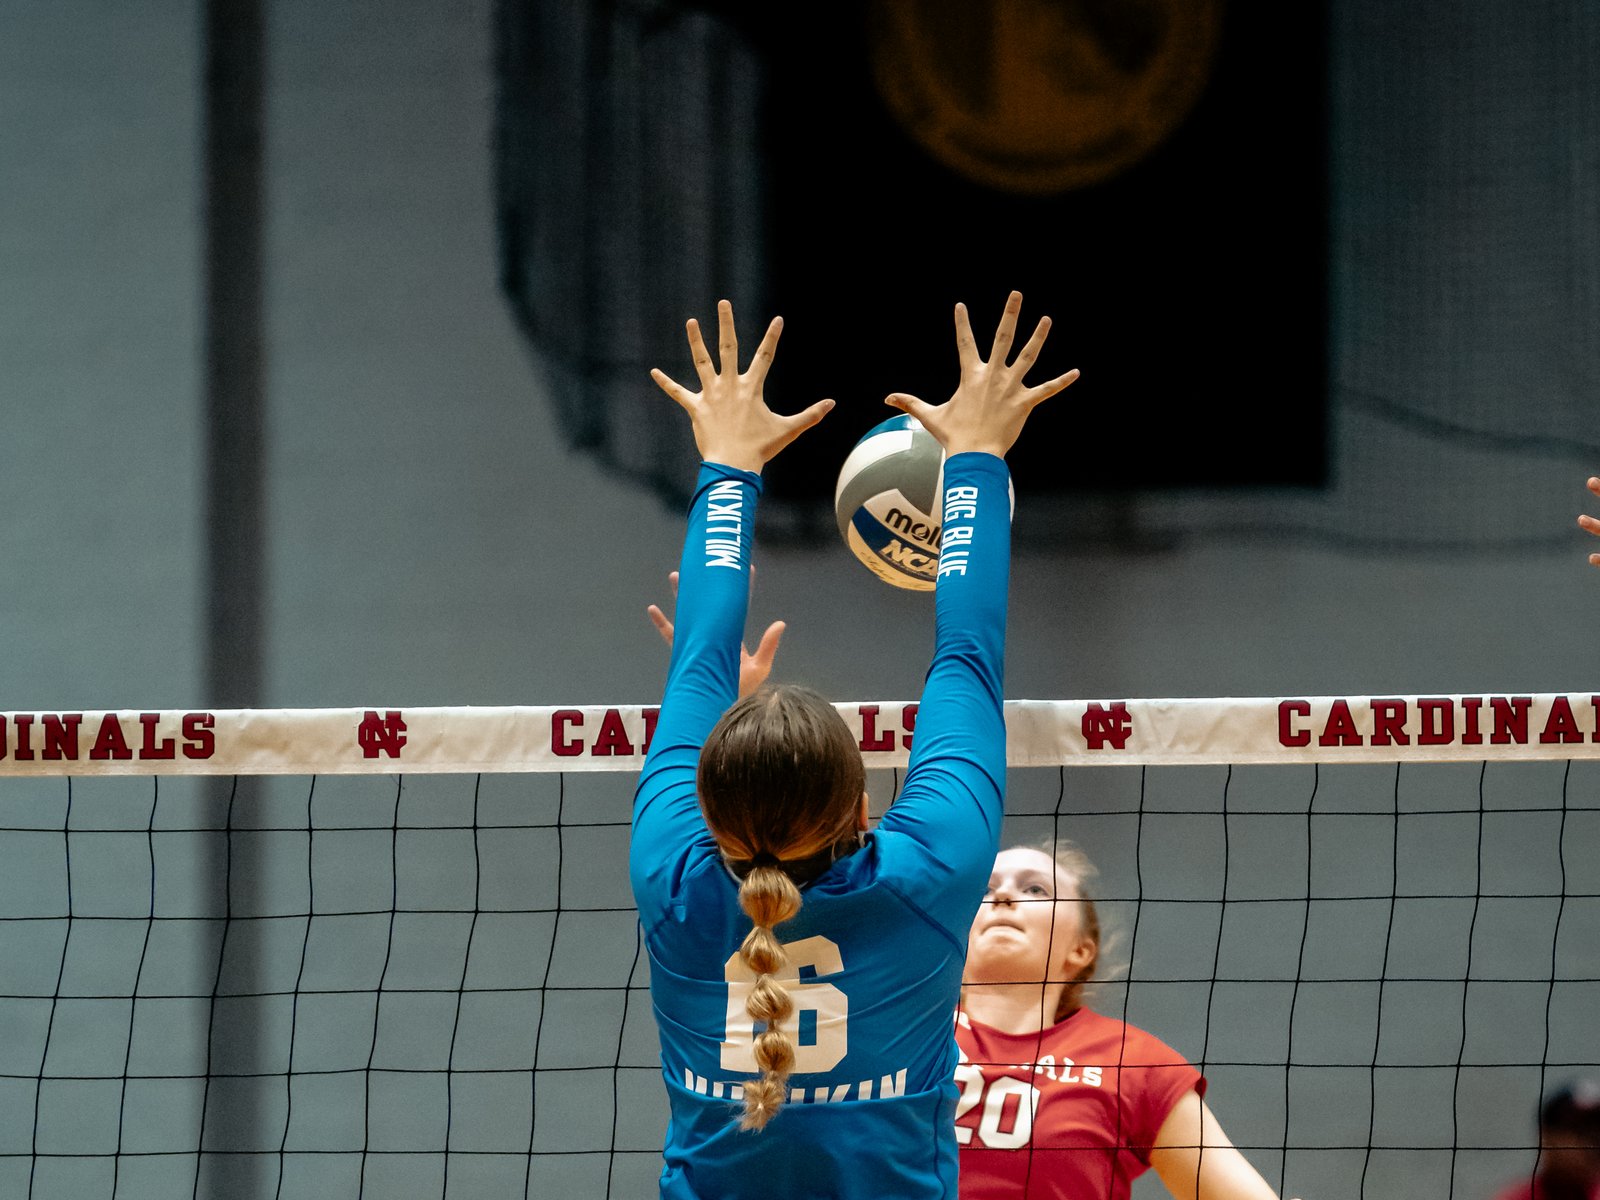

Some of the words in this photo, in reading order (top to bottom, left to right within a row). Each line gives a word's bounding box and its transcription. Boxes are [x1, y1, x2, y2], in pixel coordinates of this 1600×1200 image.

[705, 480, 744, 571] MILLIKIN
[944, 486, 978, 522] BIG
[936, 526, 974, 583] BLUE
[0, 712, 216, 761] INALS
[1278, 694, 1600, 748] CARDINA
[953, 1064, 1042, 1150] 20
